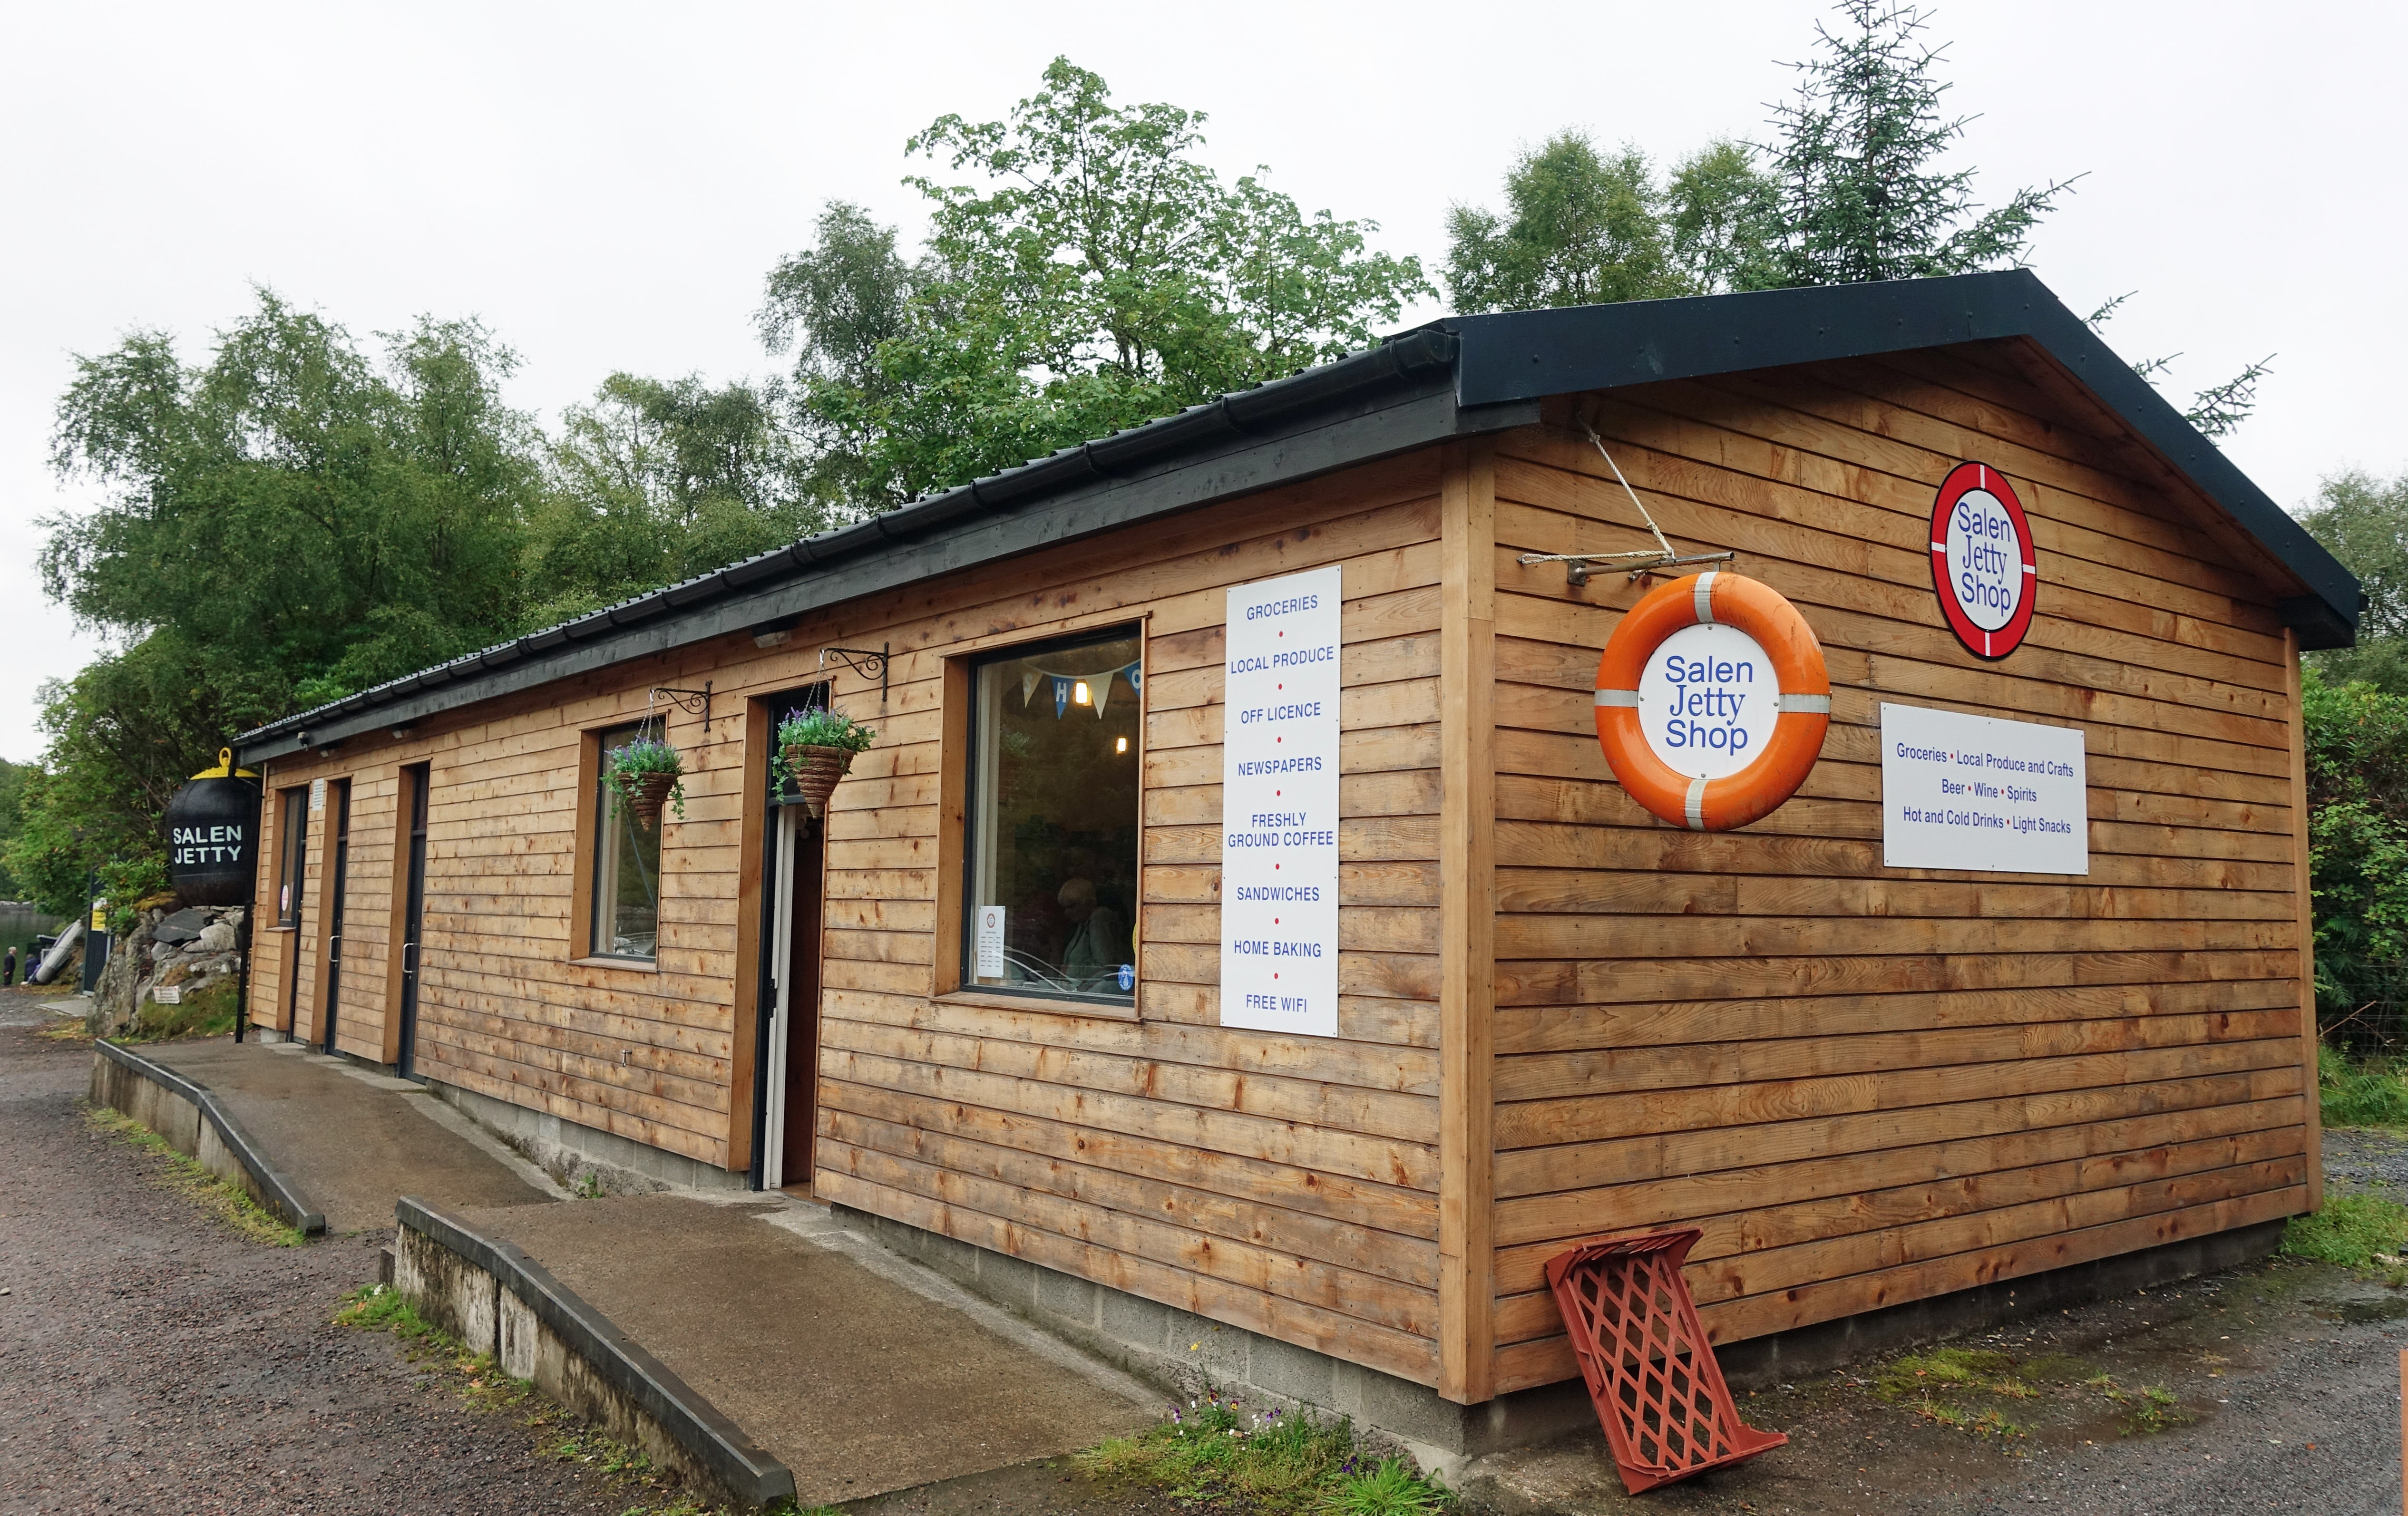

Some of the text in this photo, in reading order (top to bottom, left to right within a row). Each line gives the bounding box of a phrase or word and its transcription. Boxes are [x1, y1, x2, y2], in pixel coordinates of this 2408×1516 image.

[1958, 503, 2010, 543] Salen
[1962, 534, 2007, 584] Jetty
[1962, 572, 2011, 616] Shop
[1247, 595, 1318, 620] GROCERIES
[1231, 646, 1334, 674] LOCAL PRODUCE
[1666, 656, 1754, 684] Salen
[1241, 702, 1321, 724] OFF LICENCE
[1669, 685, 1746, 726] Jetty
[1666, 719, 1749, 756] Shop
[1238, 757, 1322, 776] NEWSPAPERS
[1897, 742, 2074, 777] Groceries Local Produce and Crafts
[1942, 778, 2037, 803] Beer Wine Spirits
[1252, 812, 1306, 827] FRESHLY
[1903, 806, 2071, 834] Hot and Cold Drinks Light Snacks
[173, 825, 242, 844] SALEN
[1228, 831, 1334, 847] GROUND COFFEE
[175, 845, 242, 864] JETTY
[1237, 887, 1320, 901] SANDWICHES
[1234, 940, 1322, 958] HOME BAKING
[1247, 994, 1307, 1013] FREE WIFI
